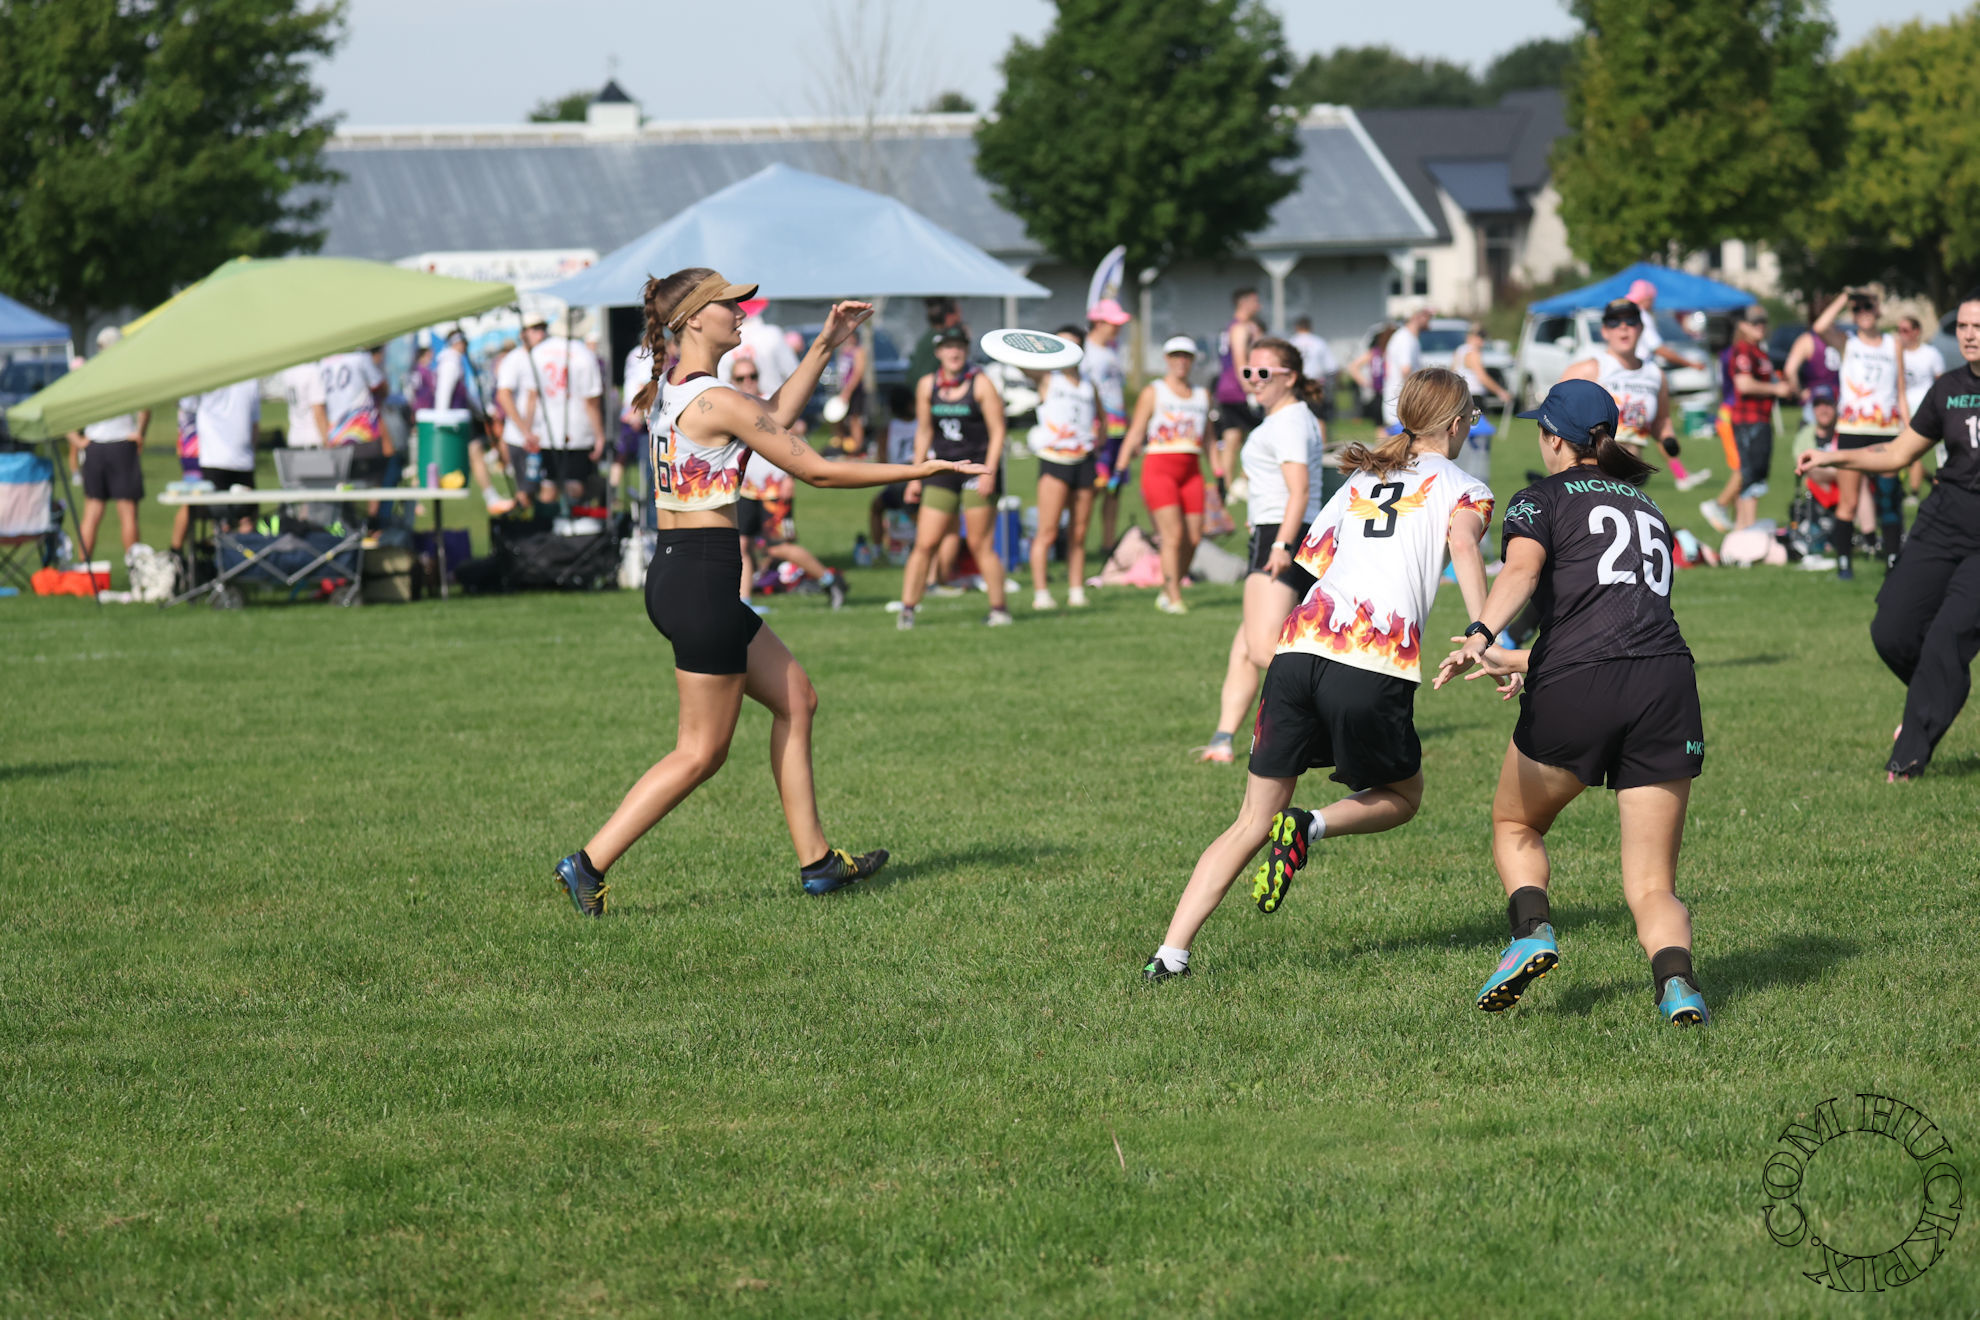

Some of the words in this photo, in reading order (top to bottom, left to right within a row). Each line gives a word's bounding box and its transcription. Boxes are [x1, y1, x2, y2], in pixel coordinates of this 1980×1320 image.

[1965, 415, 1980, 448] 1
[1363, 481, 1405, 538] 3
[1588, 505, 1672, 597] 25
[1686, 740, 1704, 755] MK
